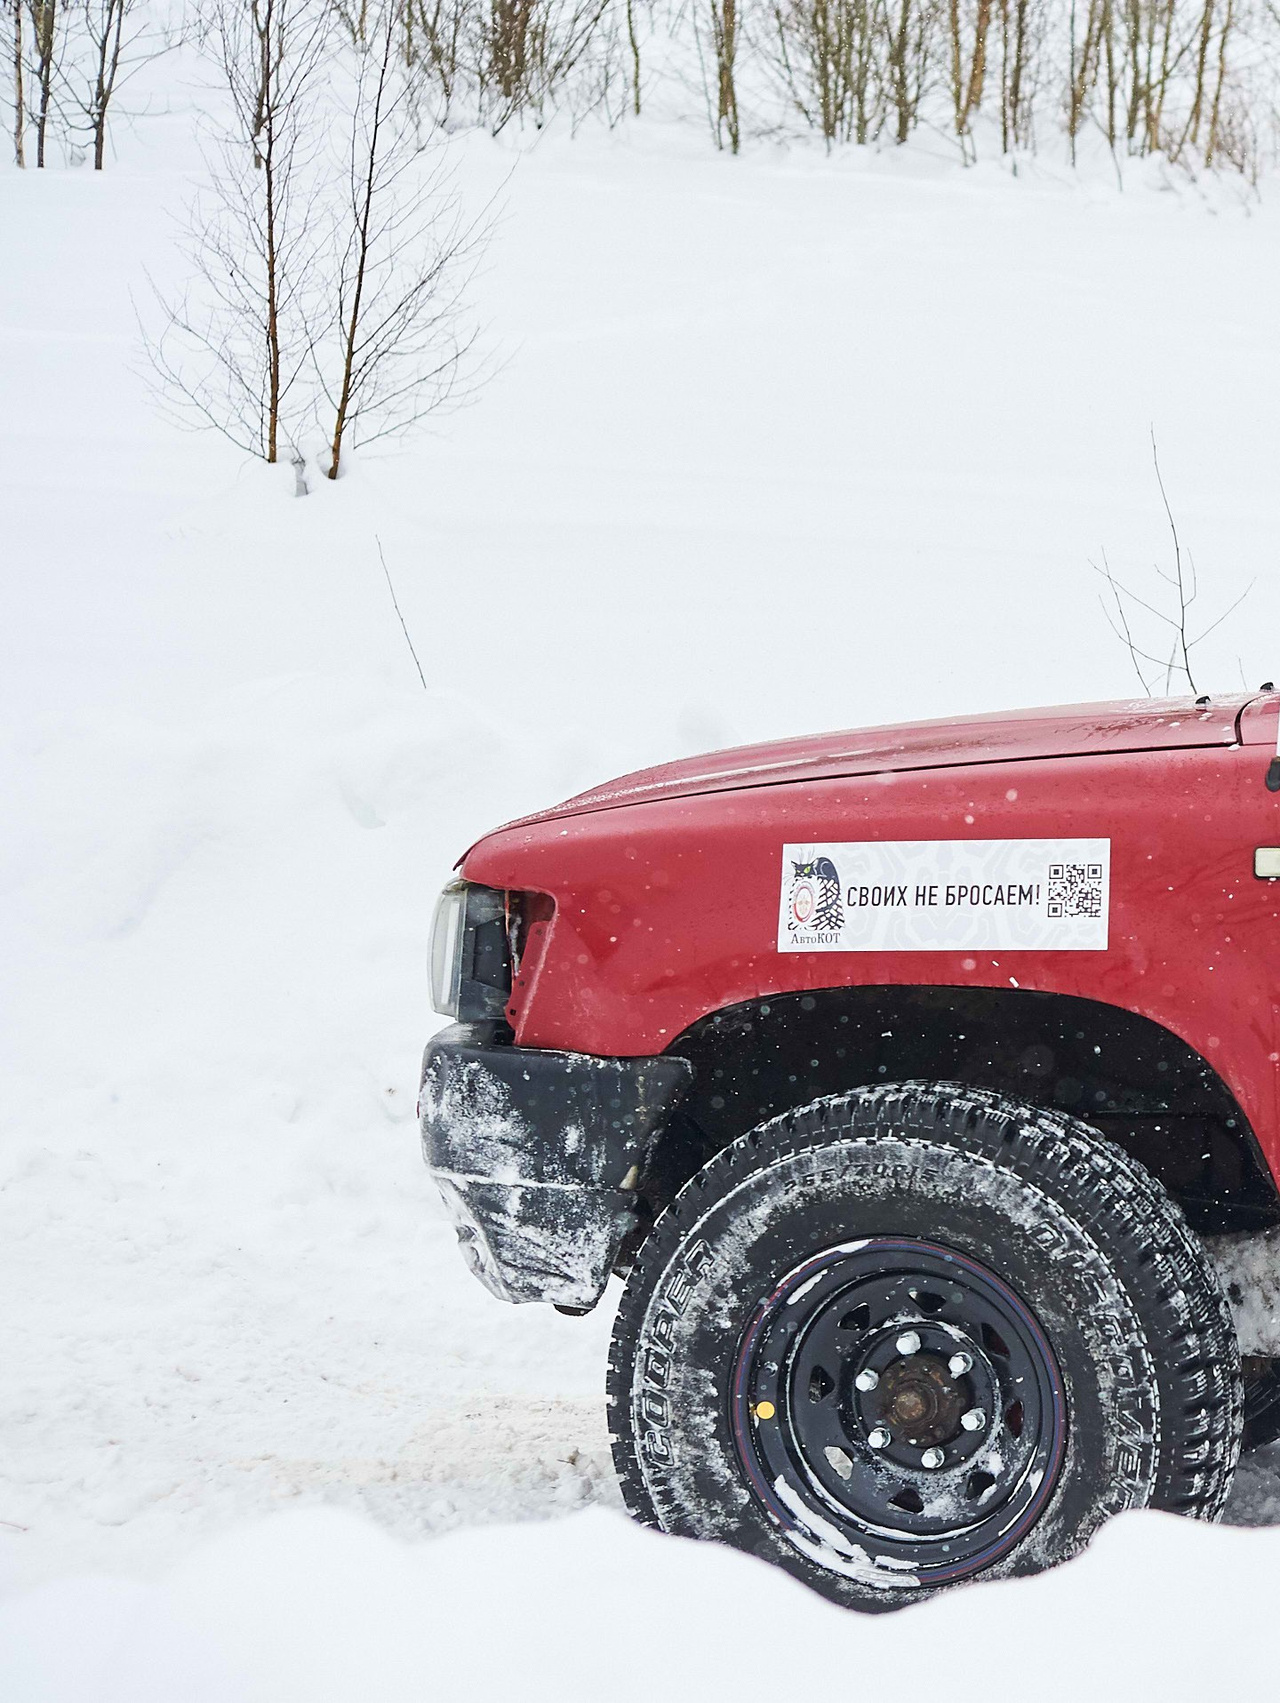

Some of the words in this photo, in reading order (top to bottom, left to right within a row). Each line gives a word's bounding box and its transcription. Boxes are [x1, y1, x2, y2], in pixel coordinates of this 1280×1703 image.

[847, 886, 909, 907] СВОИХ
[915, 886, 938, 906] НЕ
[945, 884, 1041, 906] БРОСАЕМ!
[642, 1238, 715, 1467] COOPER
